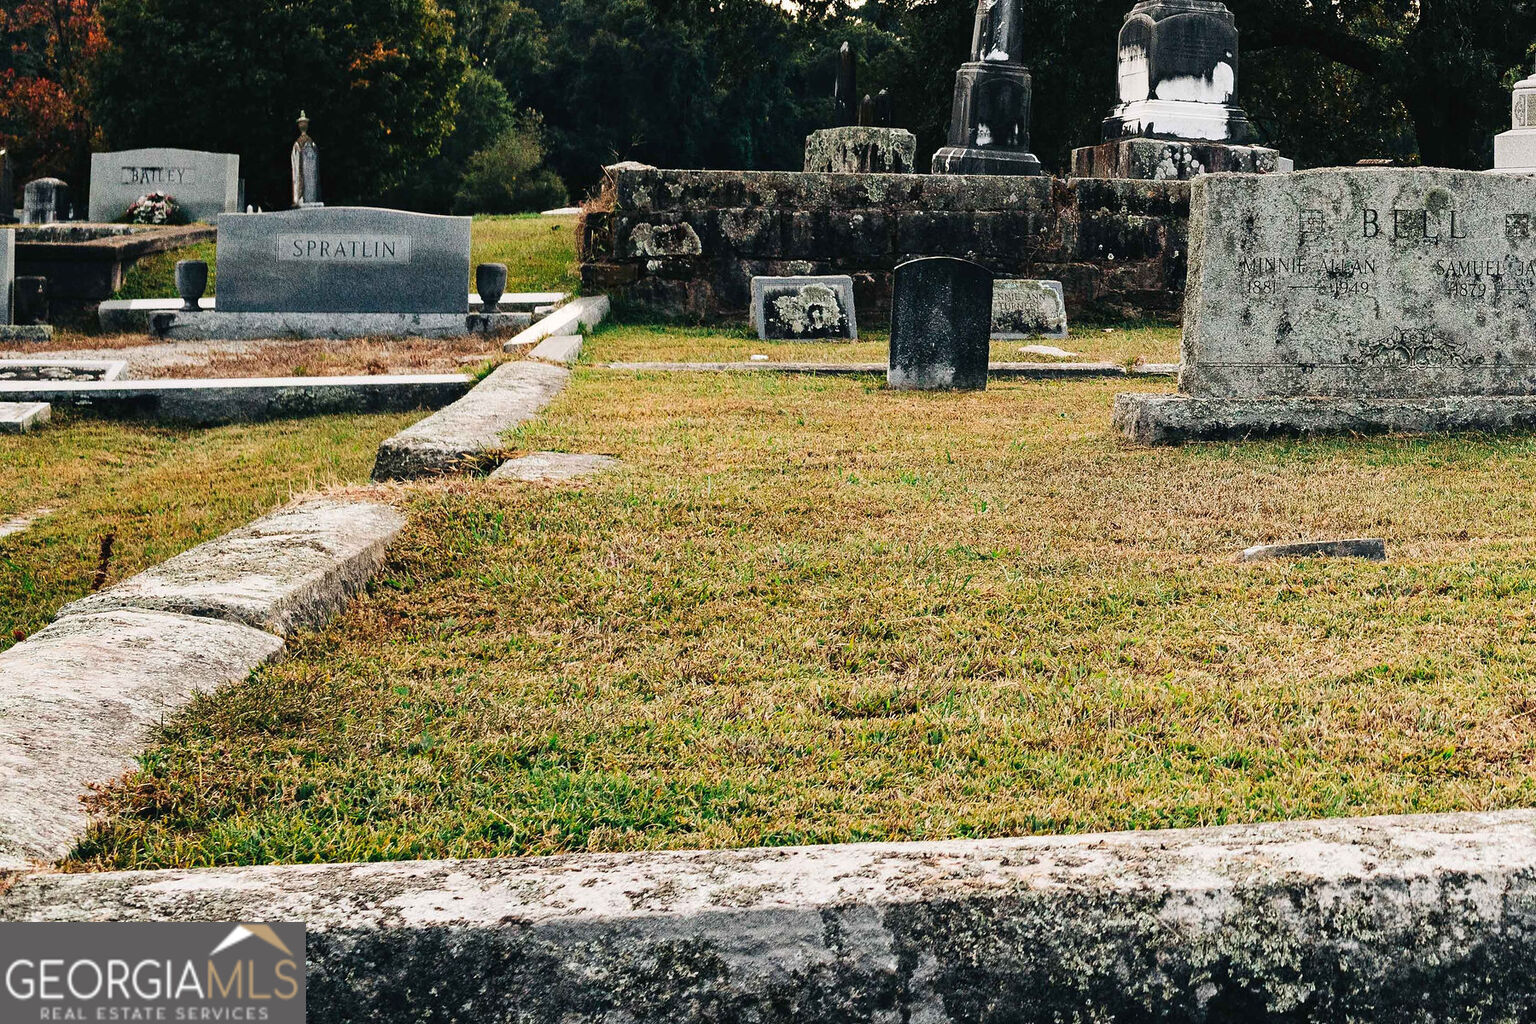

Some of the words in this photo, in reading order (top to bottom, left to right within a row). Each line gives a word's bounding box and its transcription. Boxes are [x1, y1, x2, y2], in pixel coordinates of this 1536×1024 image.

[131, 167, 185, 184] BAILEY
[1362, 208, 1467, 239] BELL
[292, 239, 396, 258] SPRATLIN
[1242, 257, 1306, 274] MINNIE
[1319, 258, 1376, 275] ALLAN
[1436, 259, 1505, 277] SAMUEL
[1248, 280, 1276, 294] 1881
[1334, 280, 1369, 295] 1949
[1453, 283, 1486, 297] 1879
